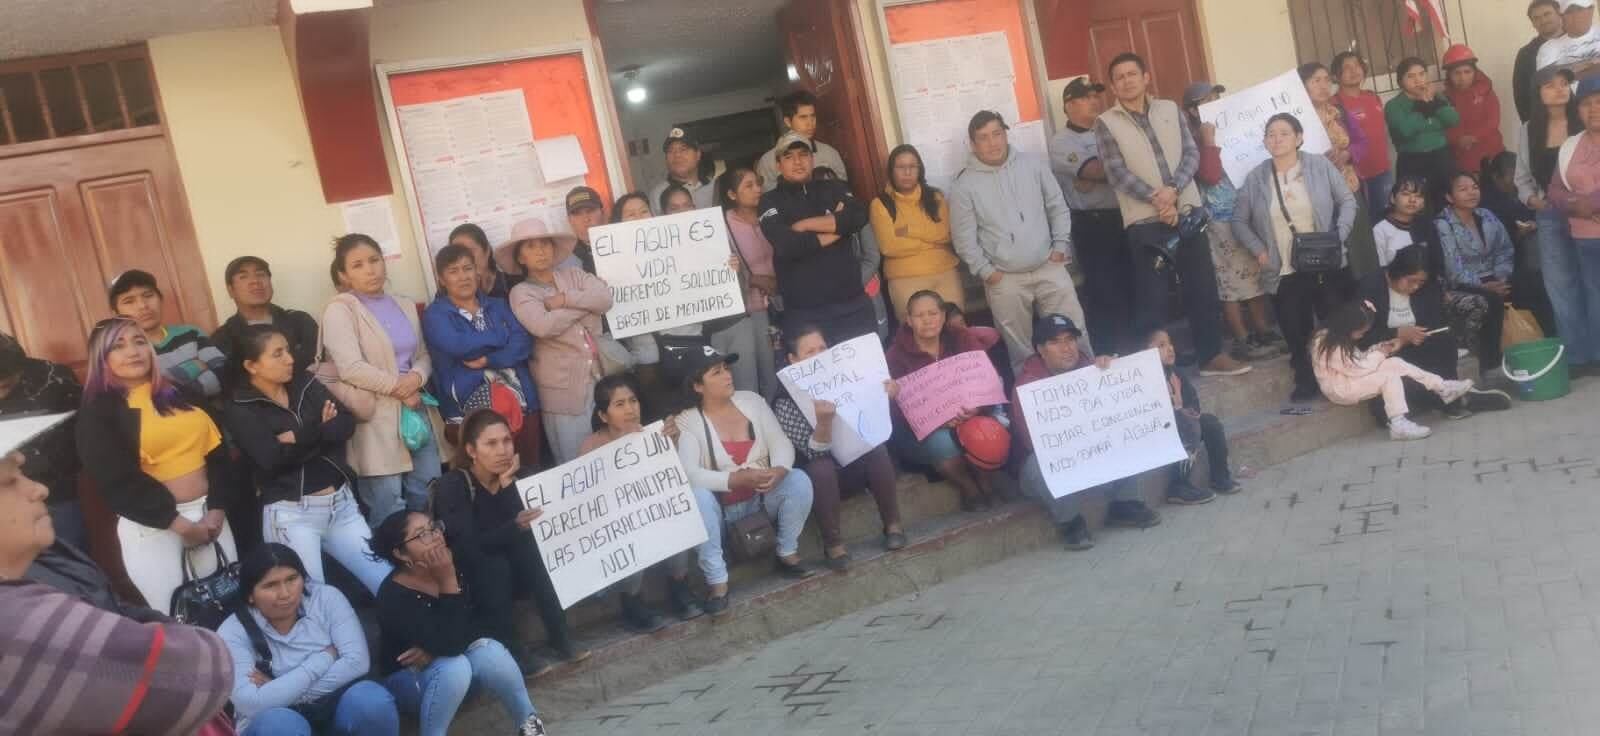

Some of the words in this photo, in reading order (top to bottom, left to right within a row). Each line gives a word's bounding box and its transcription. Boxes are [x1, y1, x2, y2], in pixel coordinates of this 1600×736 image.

[595, 233, 620, 256] EL
[635, 224, 680, 255] AGUA
[689, 220, 715, 241] ES
[636, 256, 677, 279] VIDA
[616, 310, 650, 330] BASTA
[656, 308, 670, 321] DE
[676, 294, 734, 317] MENTIRAS
[832, 344, 856, 363] ES
[1032, 380, 1088, 405] TOMAR
[1099, 368, 1143, 390] AGUA
[1037, 406, 1072, 424] NOS
[1079, 397, 1103, 412] DA
[1111, 385, 1143, 402] VIDA
[1041, 425, 1085, 449] TOMAR
[524, 482, 551, 508] EL
[561, 457, 606, 499] AGUA
[614, 443, 640, 469] ES
[645, 432, 670, 456] UN
[538, 495, 609, 541] DERECHO
[615, 466, 688, 507] PRINCIPAL
[546, 544, 575, 573] LAS
[579, 492, 690, 555] DISTRACCIONES
